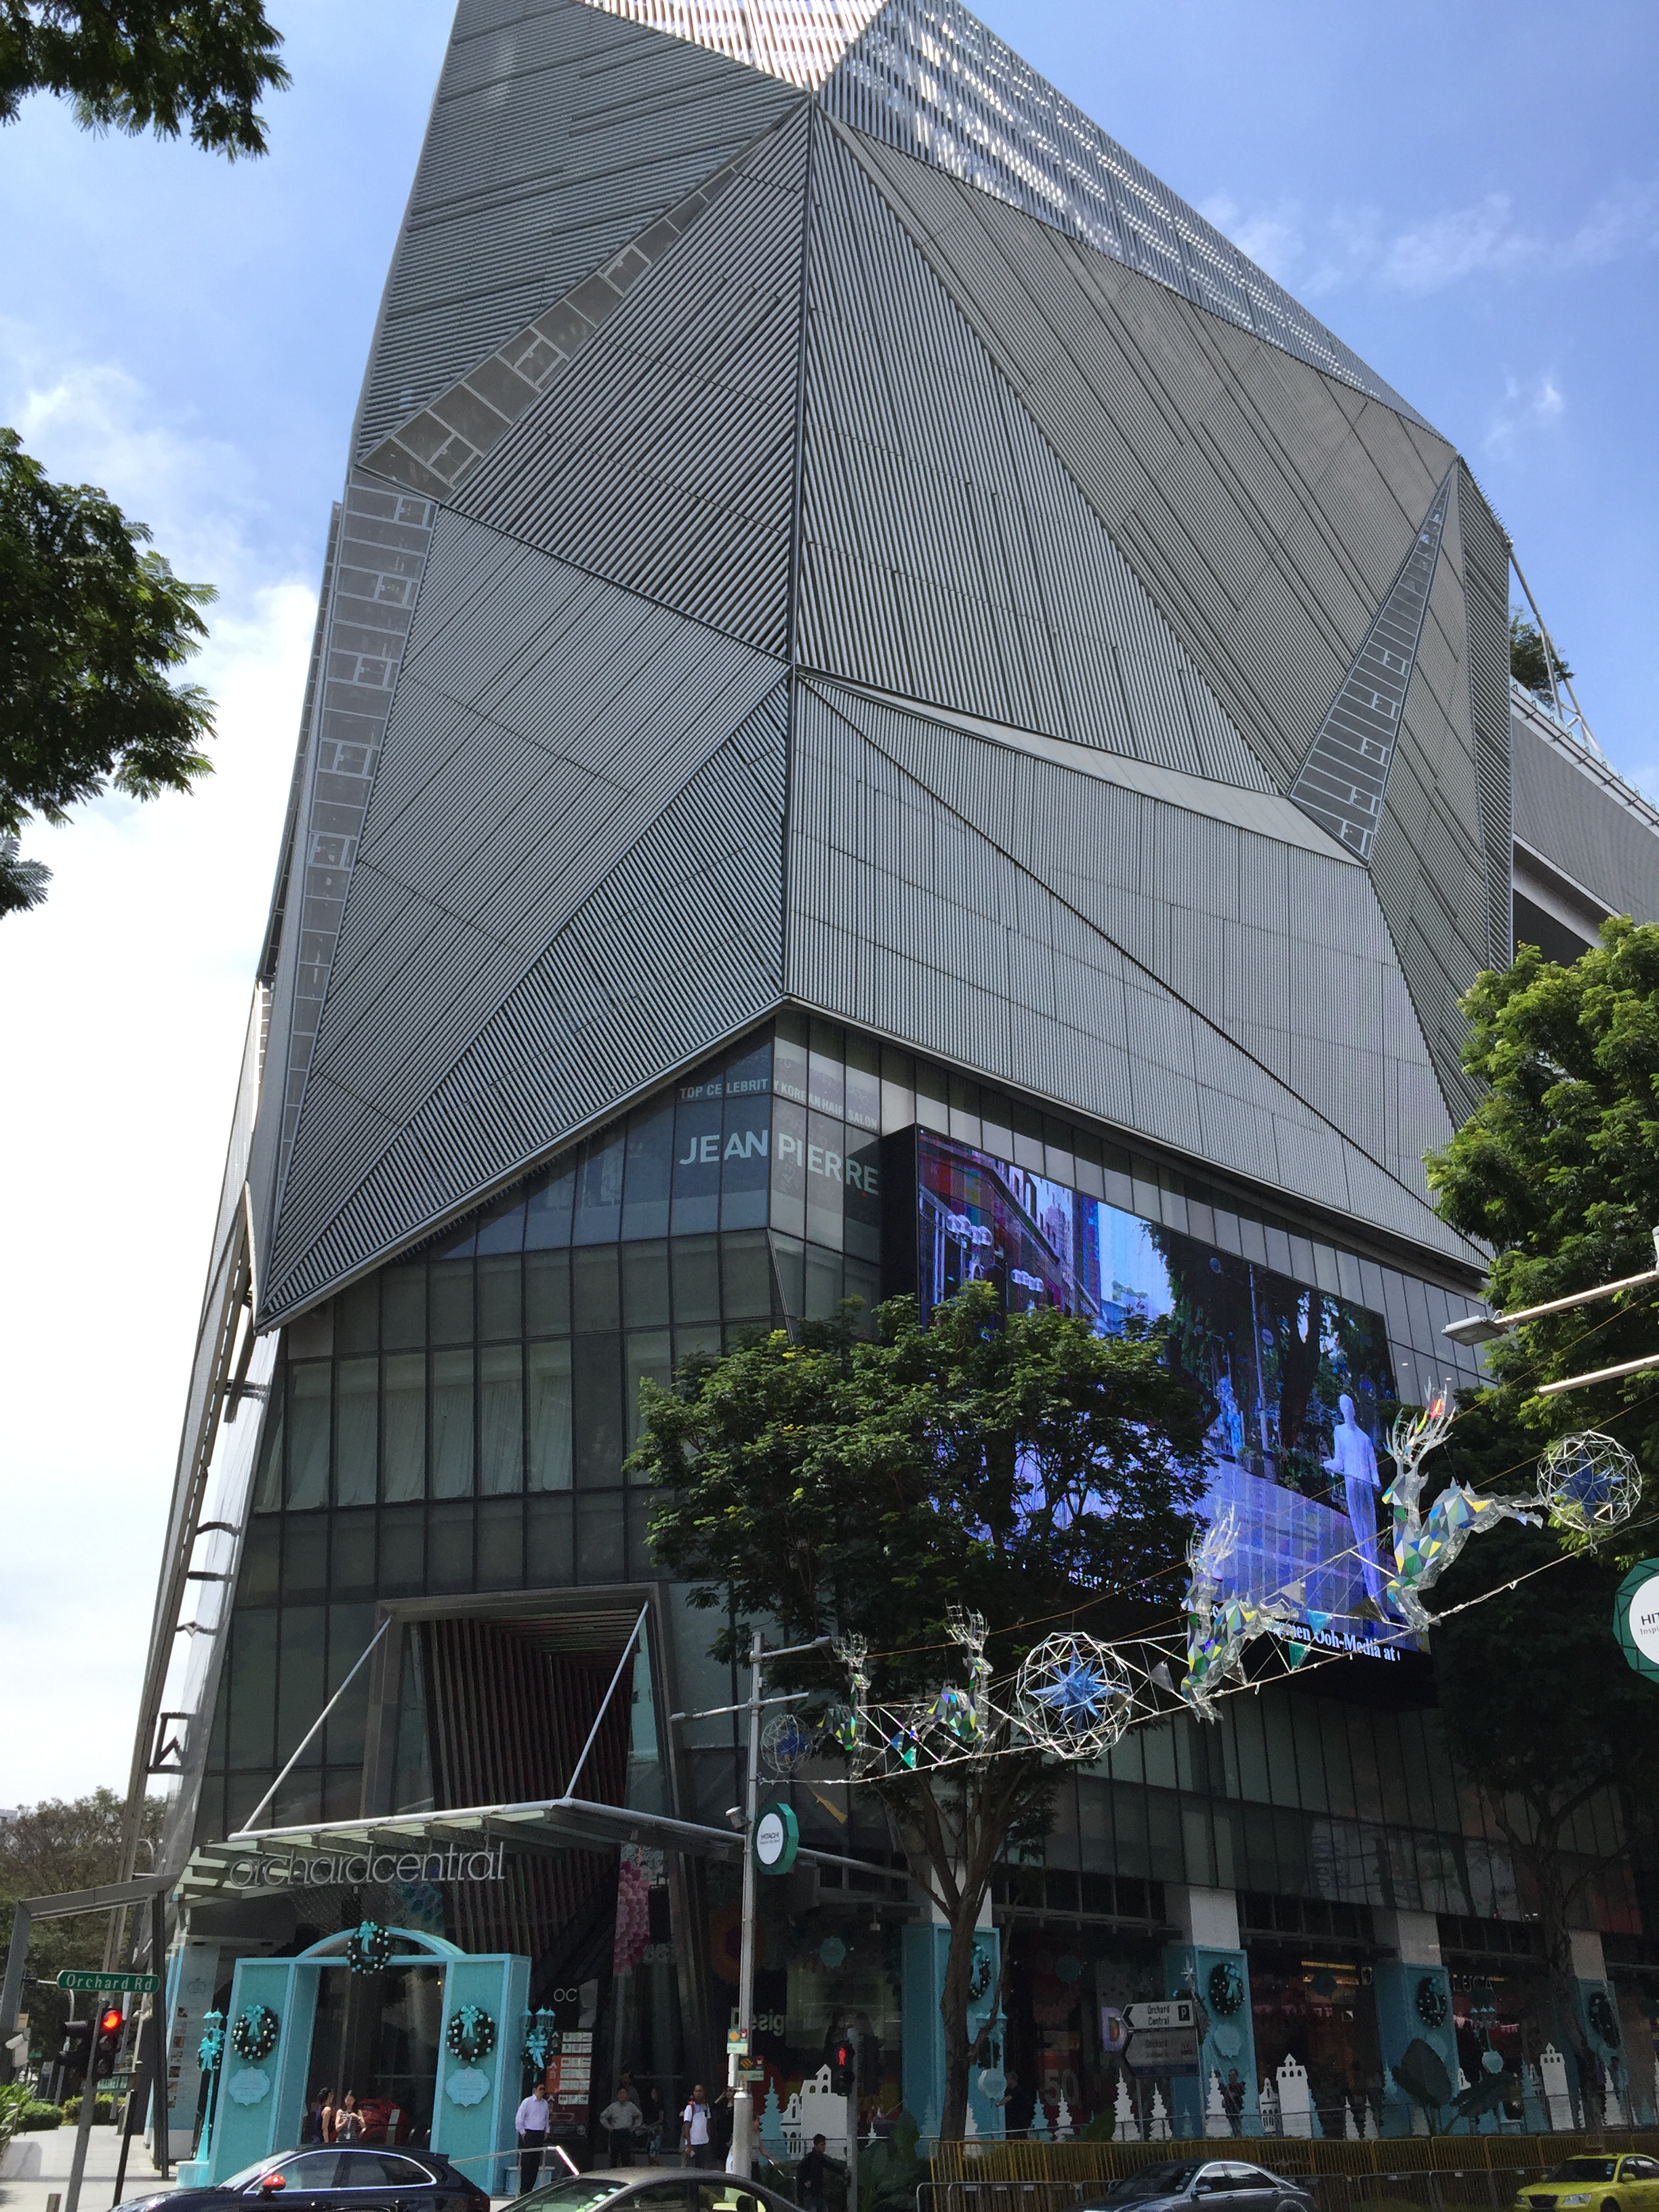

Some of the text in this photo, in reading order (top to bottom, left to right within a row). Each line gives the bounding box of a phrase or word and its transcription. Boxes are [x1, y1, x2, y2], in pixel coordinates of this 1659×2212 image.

[680, 1086, 703, 1099] TOP
[781, 1082, 821, 1107] KOREAN
[848, 1109, 878, 1130] SALON
[679, 1129, 879, 1195] JEAN PIERRE
[1383, 1646, 1395, 1661] at
[760, 1832, 779, 1840] HITACHI
[230, 1841, 505, 1887] orchardcentral
[66, 1973, 153, 1990] Orchard Rd
[553, 1987, 577, 2003] OC
[1147, 2005, 1170, 2015] Orchard
[1148, 2016, 1170, 2026] Central
